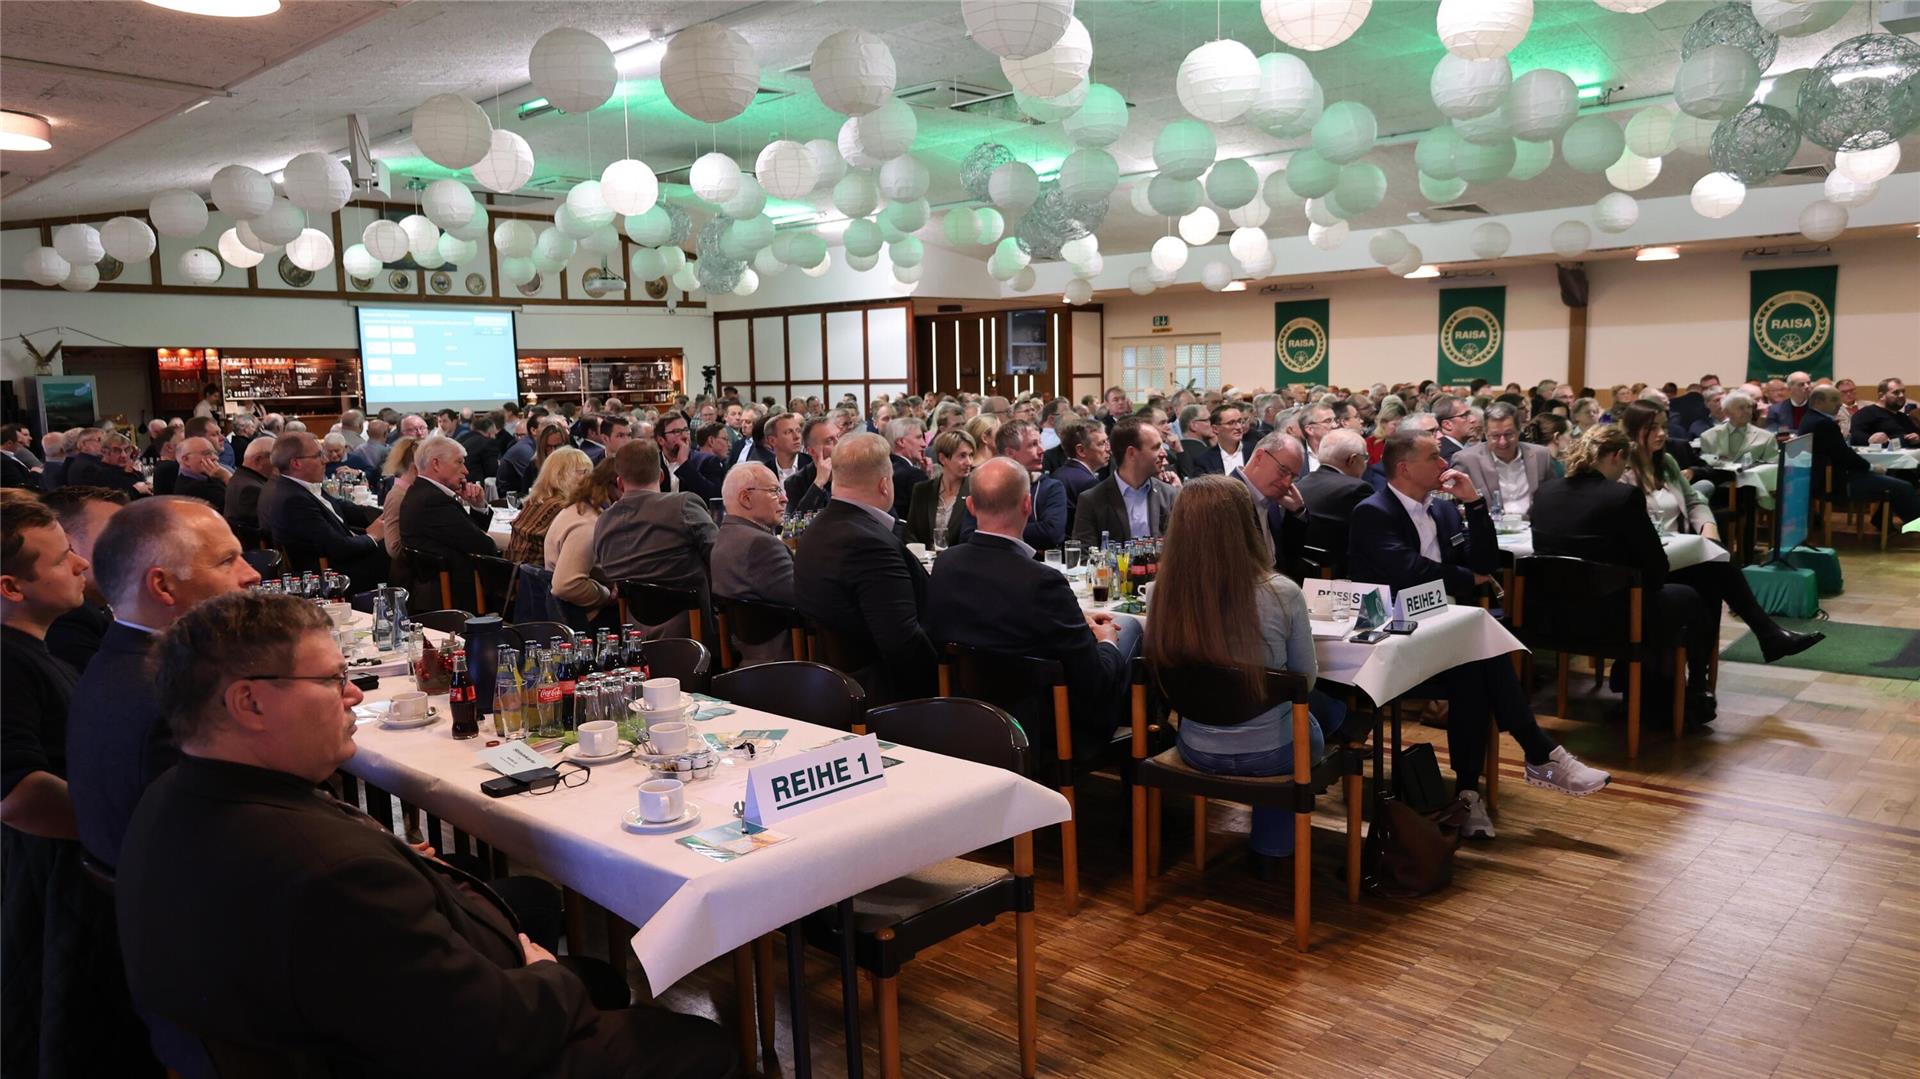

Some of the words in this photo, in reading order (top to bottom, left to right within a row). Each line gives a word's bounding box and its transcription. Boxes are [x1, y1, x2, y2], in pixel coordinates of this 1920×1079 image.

[1771, 318, 1812, 329] RAISA
[1455, 330, 1487, 339] RAISA
[1288, 338, 1315, 348] RAISA
[1406, 592, 1435, 613] REIHE
[1435, 589, 1443, 604] 2
[771, 757, 852, 802] REIHE
[857, 752, 870, 775] 1
